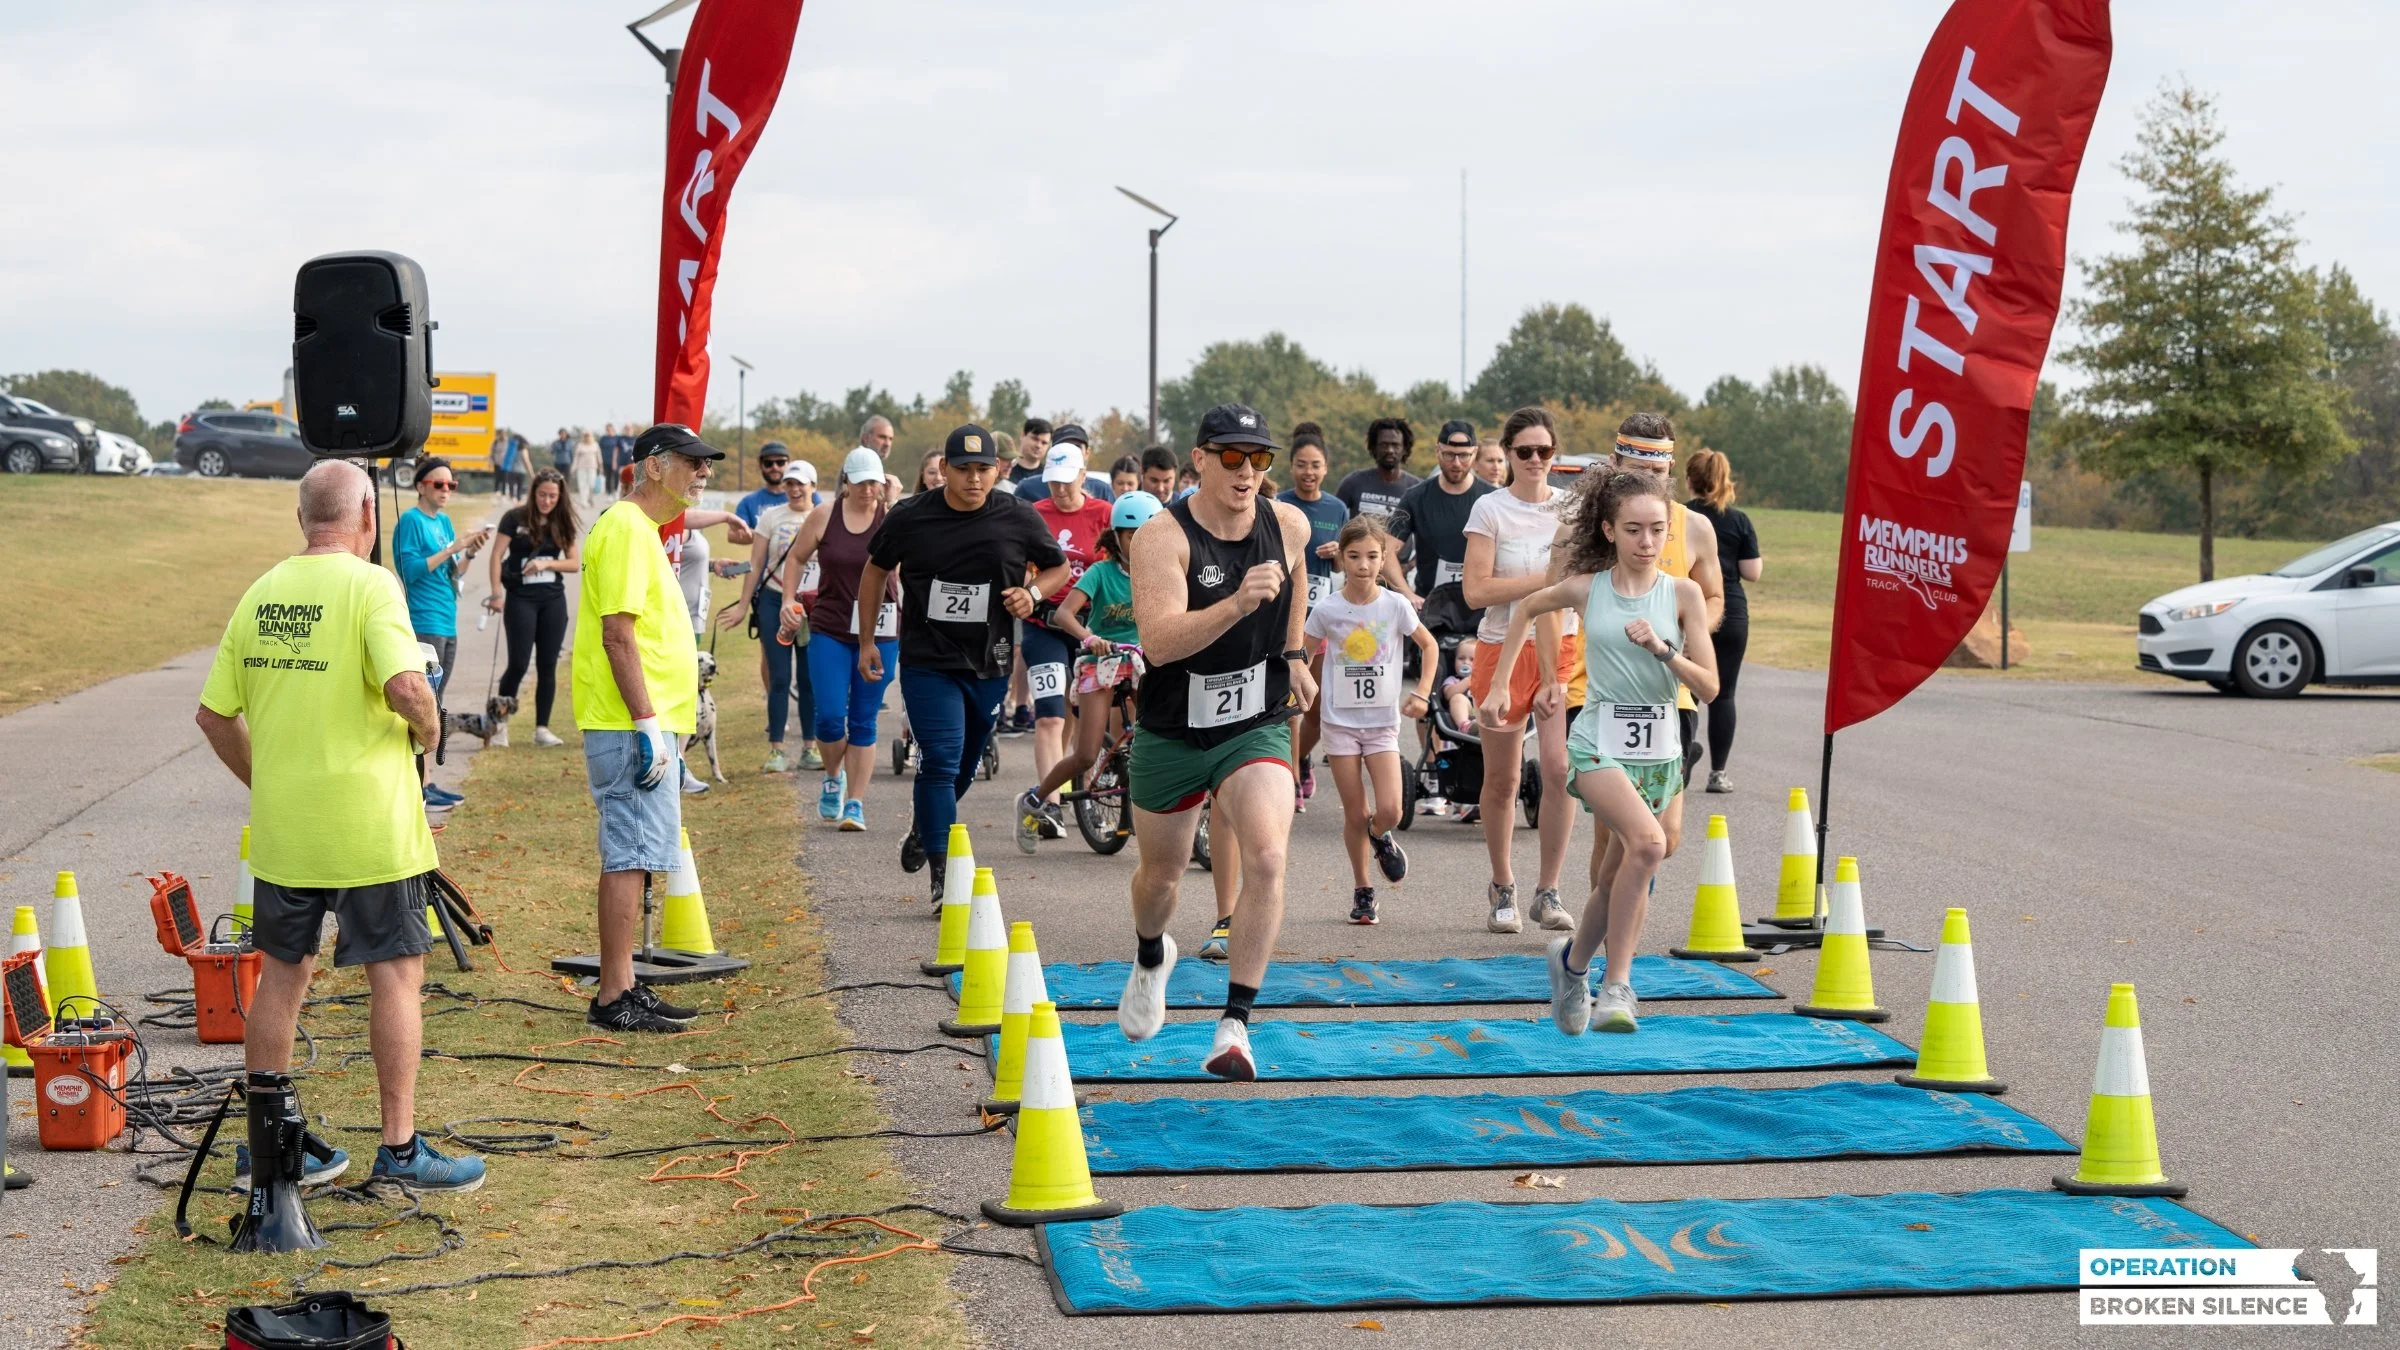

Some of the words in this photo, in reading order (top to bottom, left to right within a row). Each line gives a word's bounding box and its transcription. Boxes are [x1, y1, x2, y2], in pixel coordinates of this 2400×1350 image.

[1888, 45, 2021, 478] START
[1859, 514, 1968, 564] MEMPHIS
[1864, 544, 1952, 582] RUNNERS
[1866, 578, 1900, 592] TRACK
[1933, 590, 1958, 603] CLUB
[255, 604, 323, 622] MEMPHIS
[945, 596, 970, 614] 24
[259, 620, 312, 634] RUNNERS
[295, 660, 328, 671] CREW
[1035, 673, 1057, 691] 30
[1353, 679, 1376, 699] 18
[1216, 687, 1243, 715] 21
[1624, 721, 1652, 748] 31
